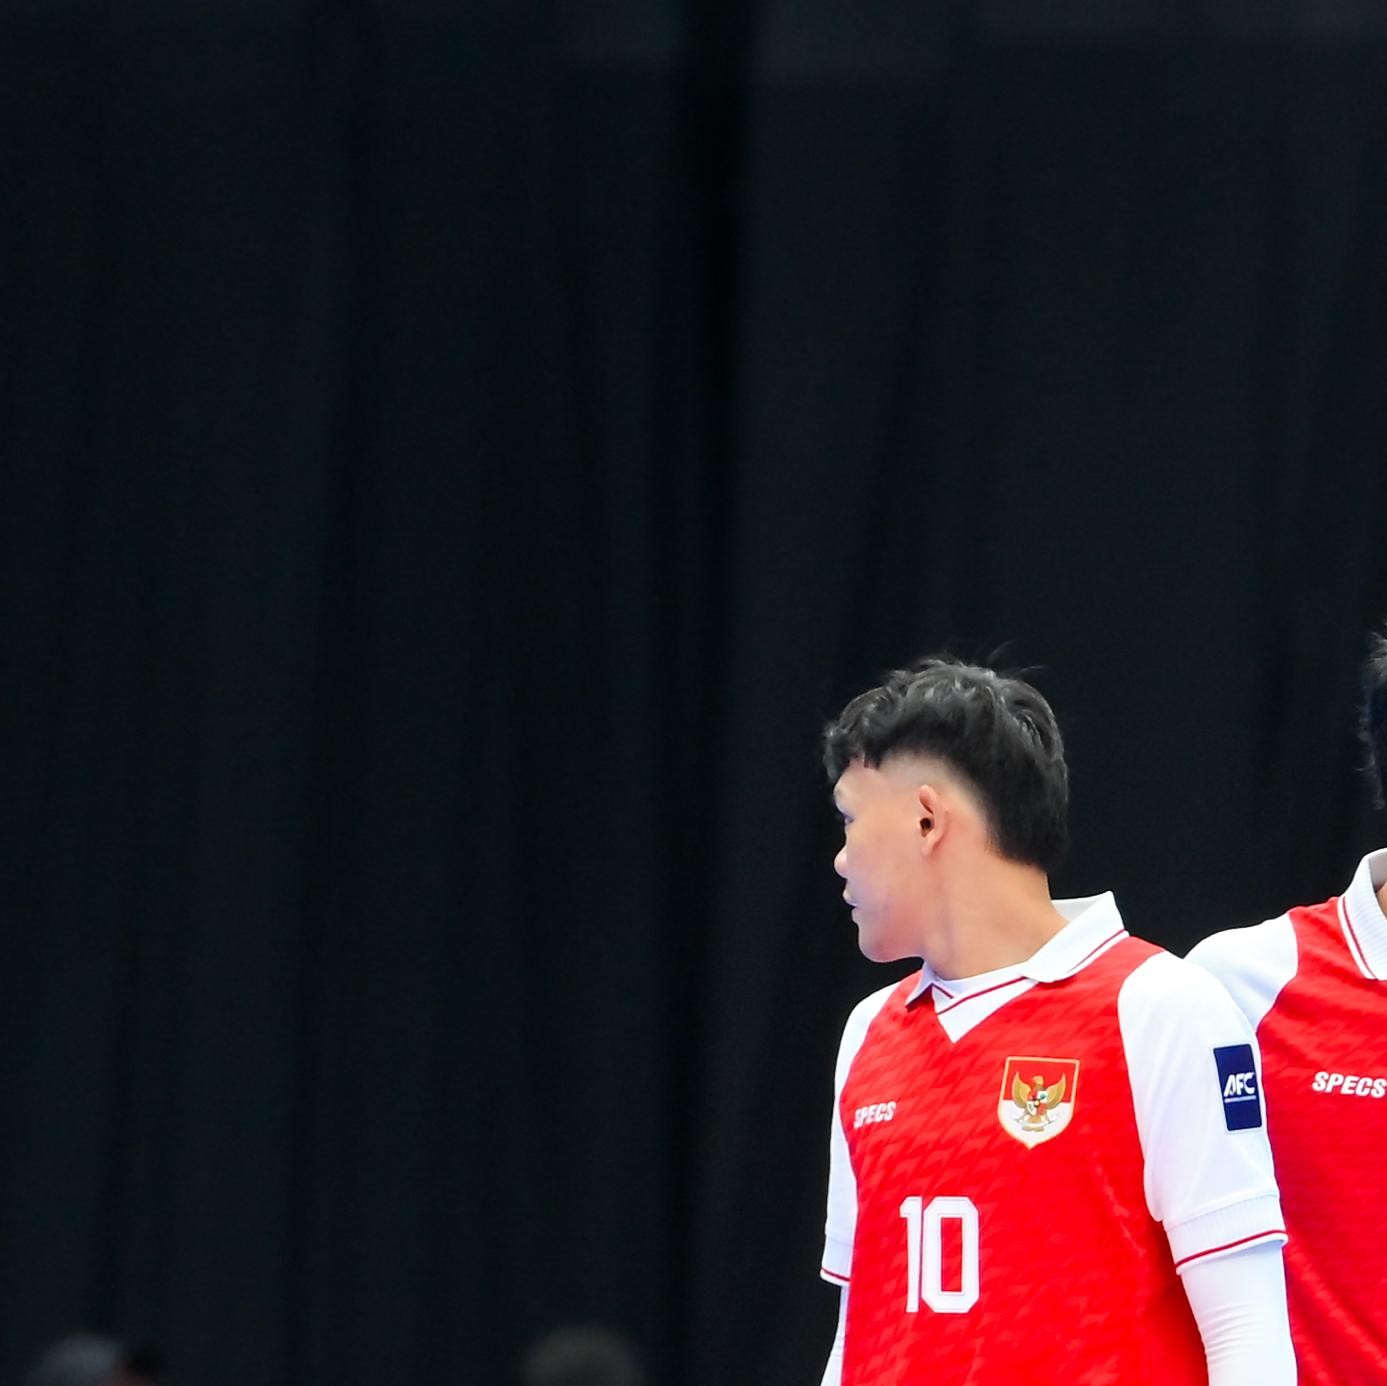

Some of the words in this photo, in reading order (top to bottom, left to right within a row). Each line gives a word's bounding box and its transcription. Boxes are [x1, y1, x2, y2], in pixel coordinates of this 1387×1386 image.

[1223, 1071, 1257, 1098] AFC
[1311, 1071, 1387, 1099] SPECS
[853, 1100, 897, 1130] SPECS
[899, 1196, 980, 1314] 10
